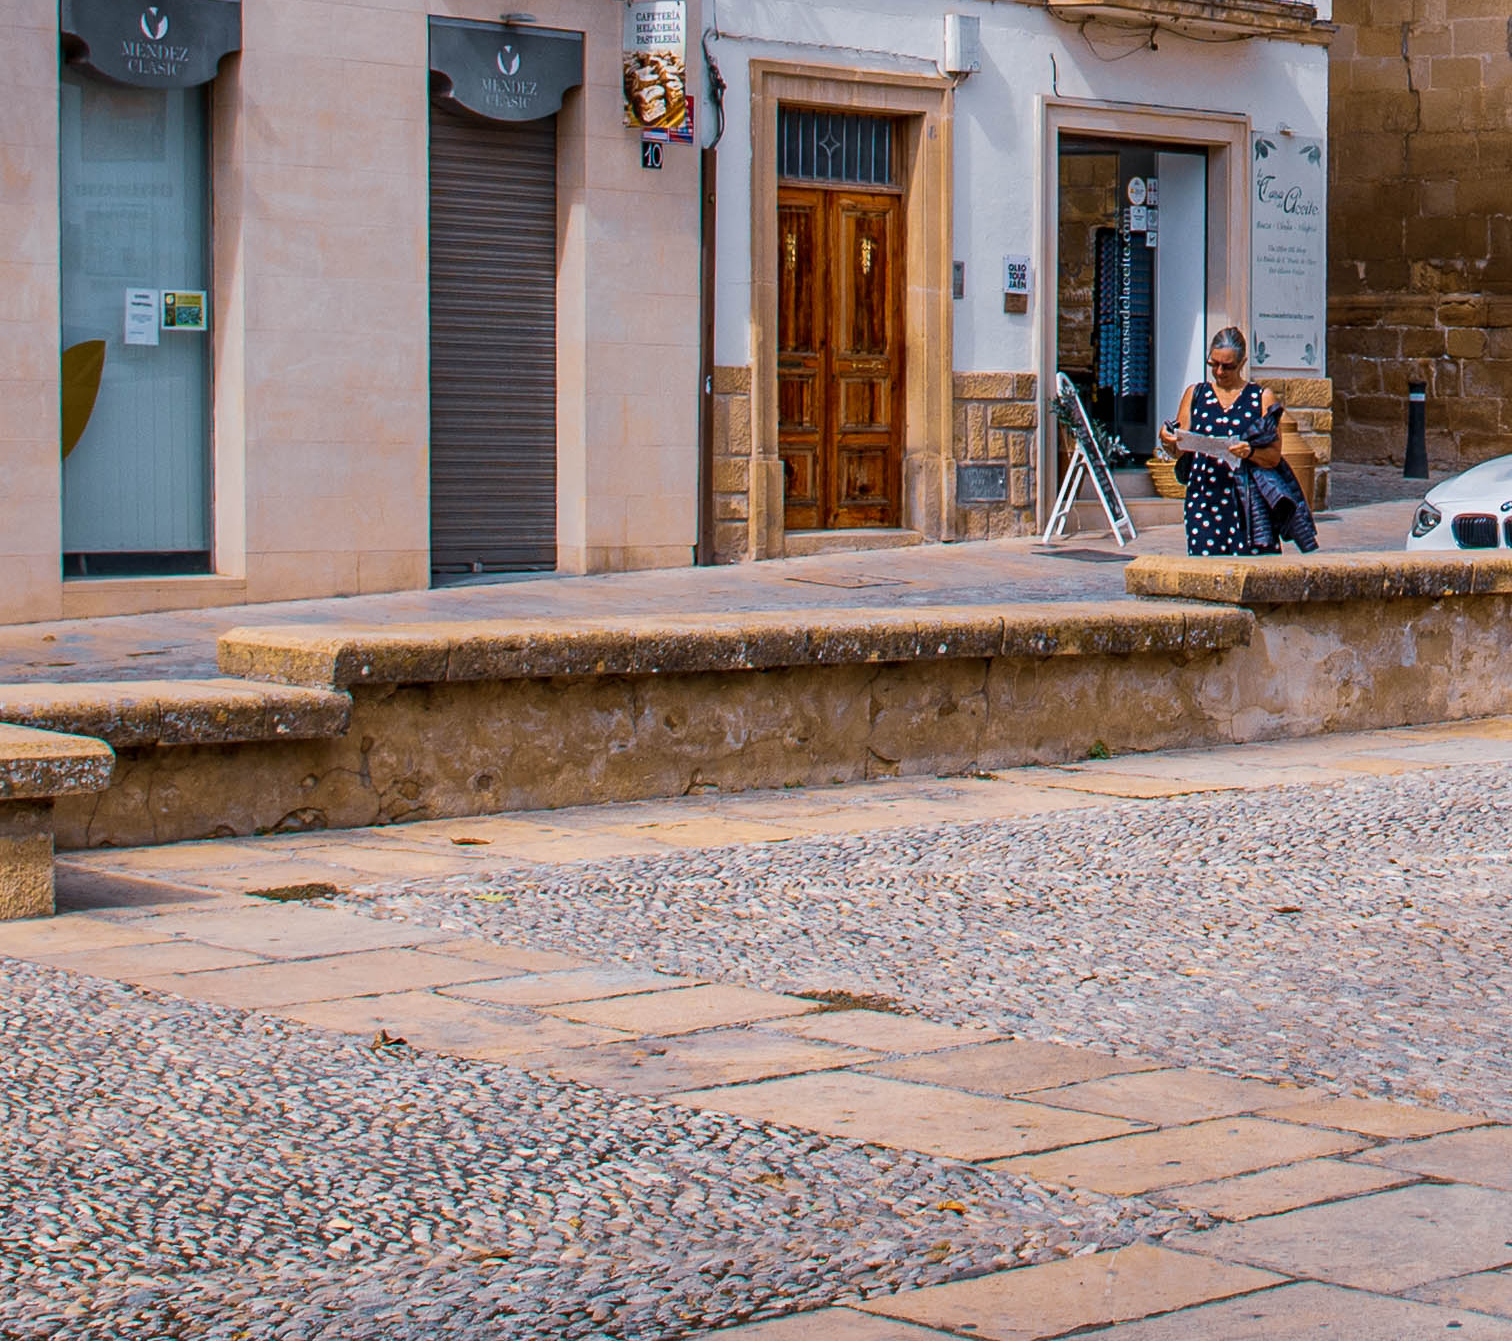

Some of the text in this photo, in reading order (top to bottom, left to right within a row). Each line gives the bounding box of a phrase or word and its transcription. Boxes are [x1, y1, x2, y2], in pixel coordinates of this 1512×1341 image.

[636, 10, 680, 21] CAFETERÍA
[636, 22, 680, 33] HELADERÍA
[636, 33, 680, 44] PASTELERÍA
[121, 40, 188, 62] MÉNDEZ
[128, 59, 182, 77] CLASIC
[486, 94, 532, 110] CLASIC
[644, 143, 662, 167] 10
[1008, 263, 1027, 271] OLEO
[1008, 272, 1026, 280] TOUR
[1119, 207, 1131, 398] www.casadelaceite.com
